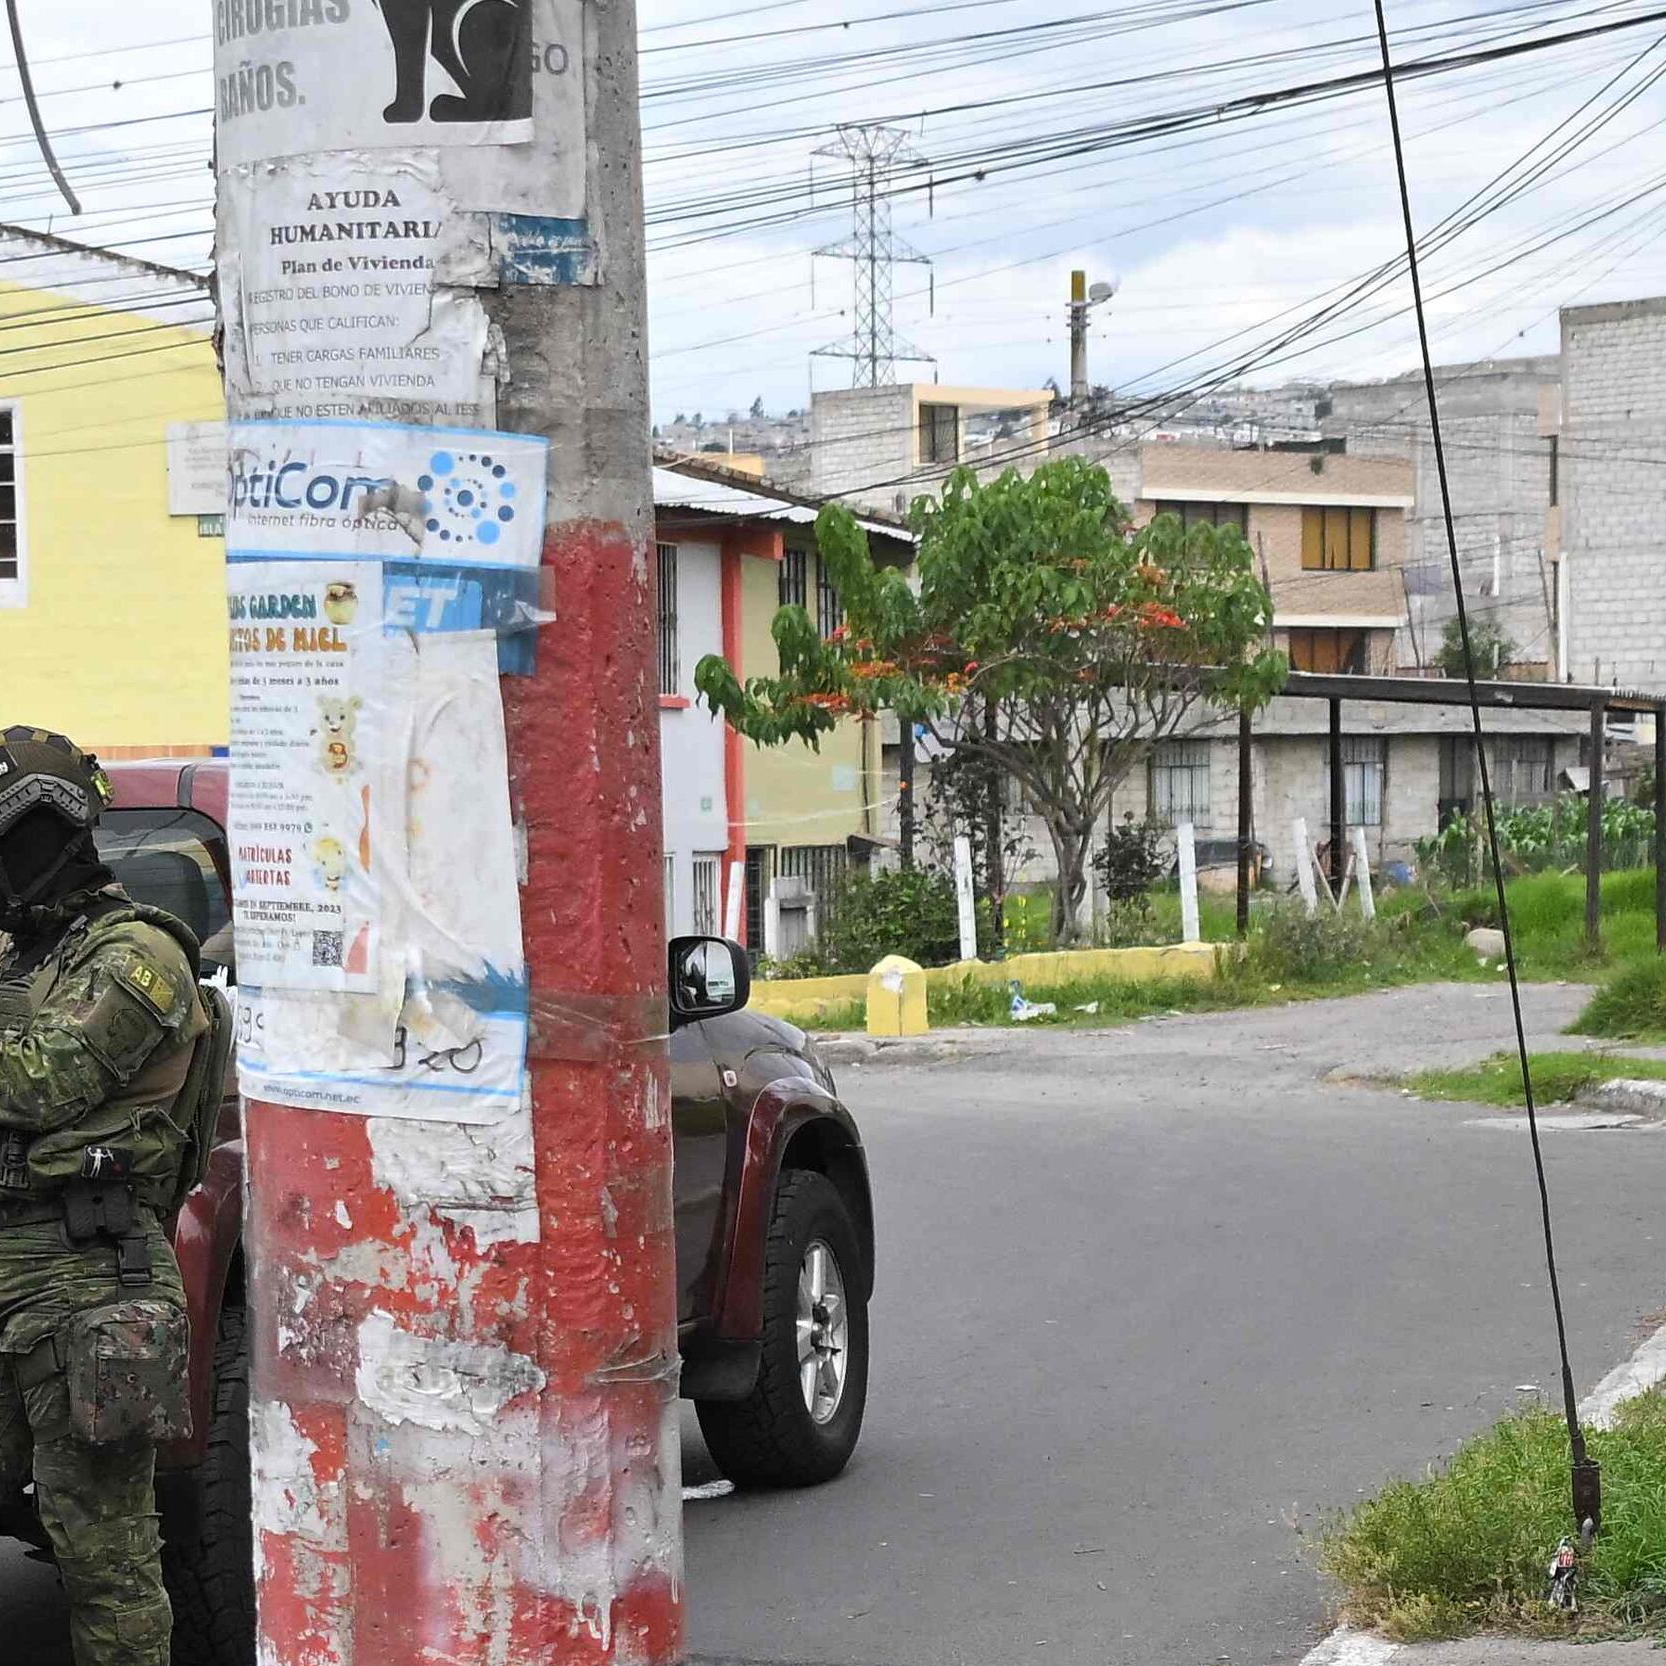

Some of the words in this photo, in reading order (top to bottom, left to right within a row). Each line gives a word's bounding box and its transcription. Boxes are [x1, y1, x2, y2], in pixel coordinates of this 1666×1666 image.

[219, 60, 306, 122] BAÑOS.
[307, 190, 401, 211] AYUDA
[282, 260, 317, 275] Plan
[321, 257, 343, 271] de
[347, 255, 435, 270] Vivienda
[297, 287, 318, 299] DEL
[322, 285, 359, 298] BONO
[363, 285, 381, 296] DE
[300, 319, 323, 333] QUE
[327, 315, 399, 330] CALIFICAN:
[270, 351, 303, 365] TENER
[306, 350, 355, 362] CARGAS
[359, 347, 441, 361] FAMILIARES
[294, 377, 312, 390] NO
[316, 375, 364, 389] TENGAN
[369, 374, 435, 387] VIVIENDA
[296, 404, 312, 418] NO
[316, 403, 354, 417] ESTEN
[247, 511, 294, 527] internet
[298, 512, 338, 528] fibra
[342, 514, 398, 531] óptica
[266, 627, 286, 651] DE
[293, 627, 347, 652] MIEL
[315, 676, 339, 685] años
[247, 869, 291, 886] ABIERTAS
[317, 905, 341, 913] 2023
[130, 965, 153, 987] AB
